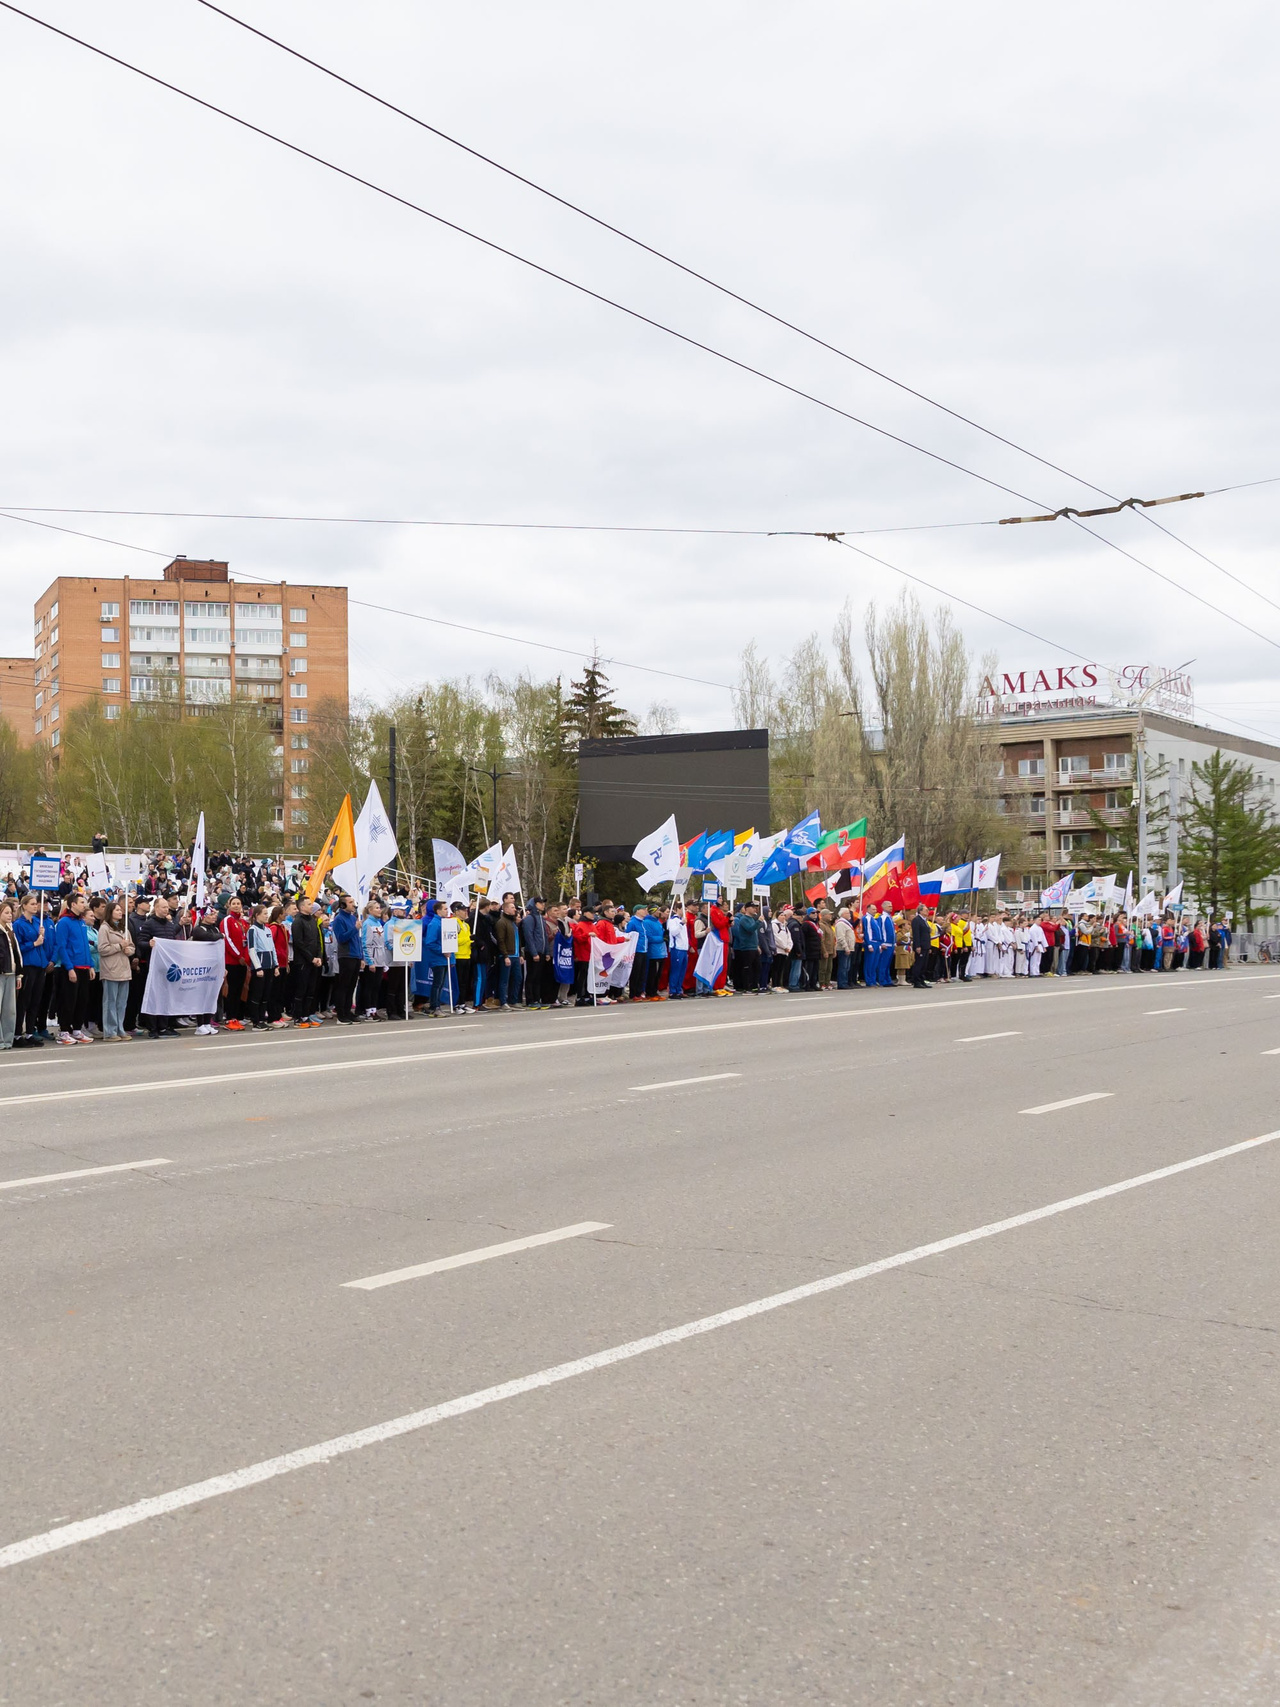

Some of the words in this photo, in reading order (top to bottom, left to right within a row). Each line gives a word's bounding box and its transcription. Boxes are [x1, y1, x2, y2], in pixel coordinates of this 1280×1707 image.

[978, 663, 1098, 698] AMAKS
[976, 695, 1097, 717] Центральная
[182, 966, 212, 976] РОССЕТИ
